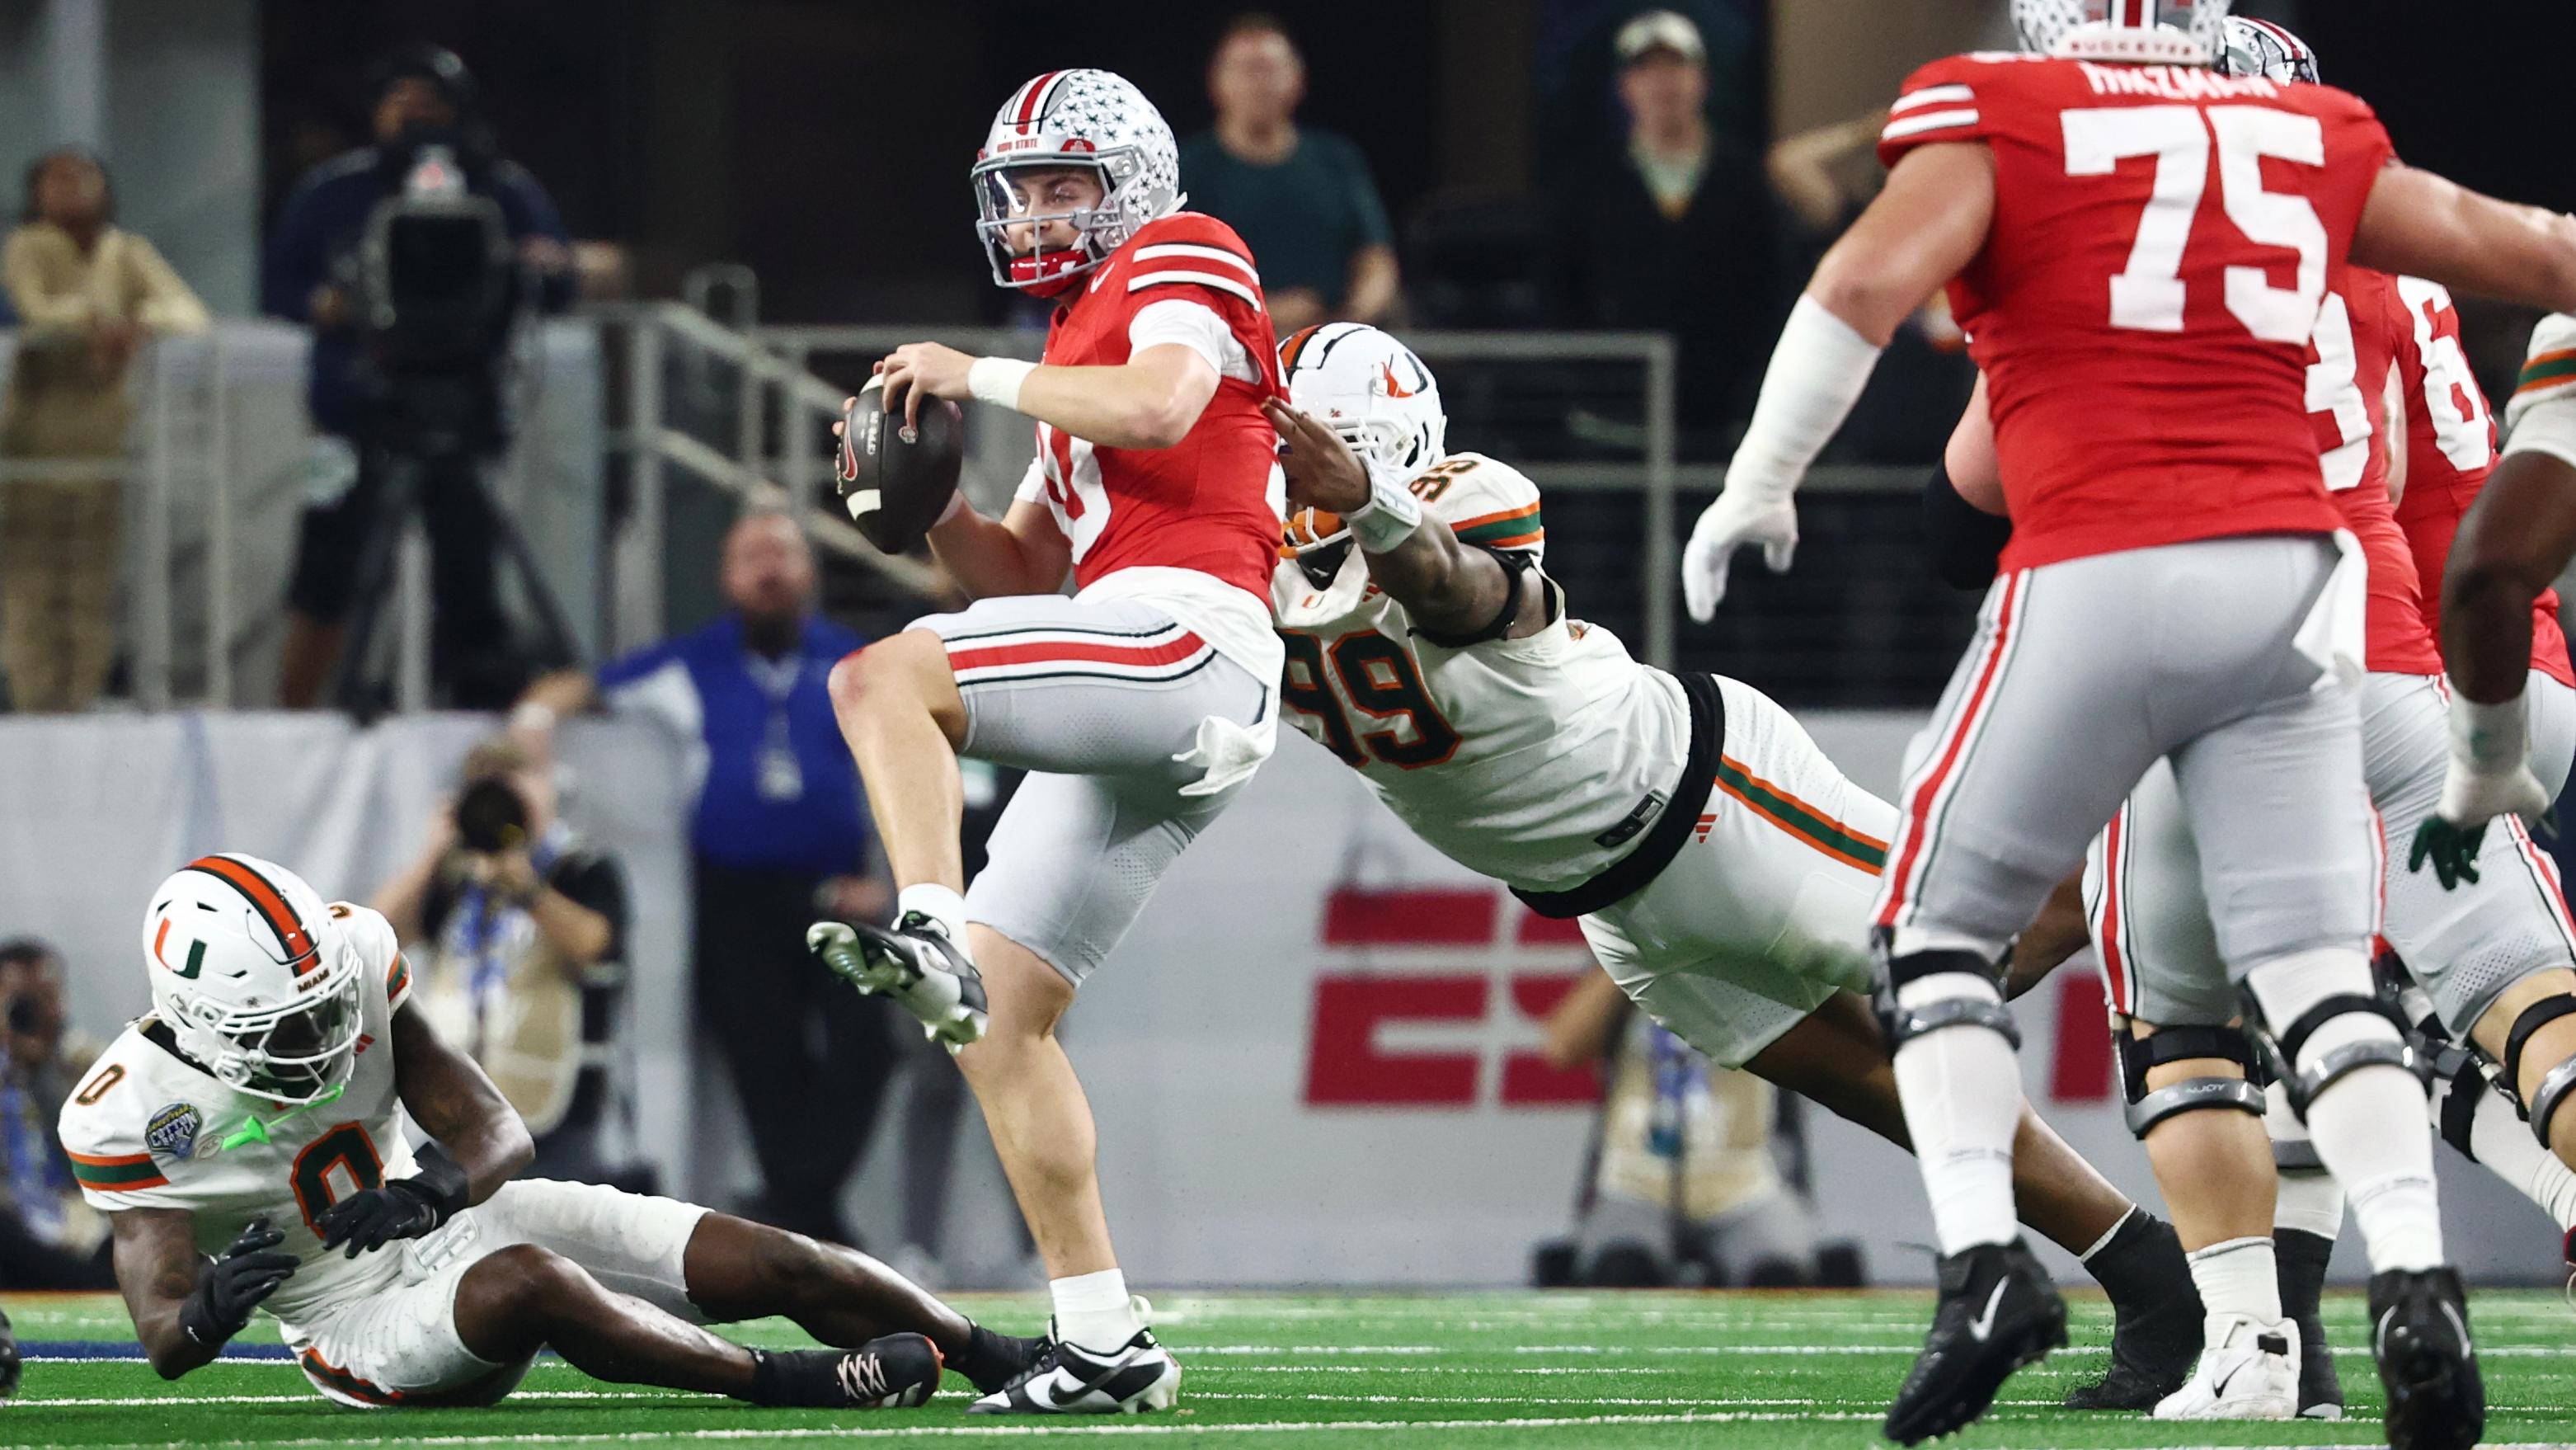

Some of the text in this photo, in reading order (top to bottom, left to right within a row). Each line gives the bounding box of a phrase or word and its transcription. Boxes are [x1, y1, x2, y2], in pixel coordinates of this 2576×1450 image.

[2070, 40, 2192, 55] BUCKEYES
[2060, 105, 2329, 346] 75
[1280, 628, 1464, 770] 99
[297, 967, 331, 993] MIAMI
[75, 1063, 127, 1106] 0
[289, 1120, 387, 1241] 0
